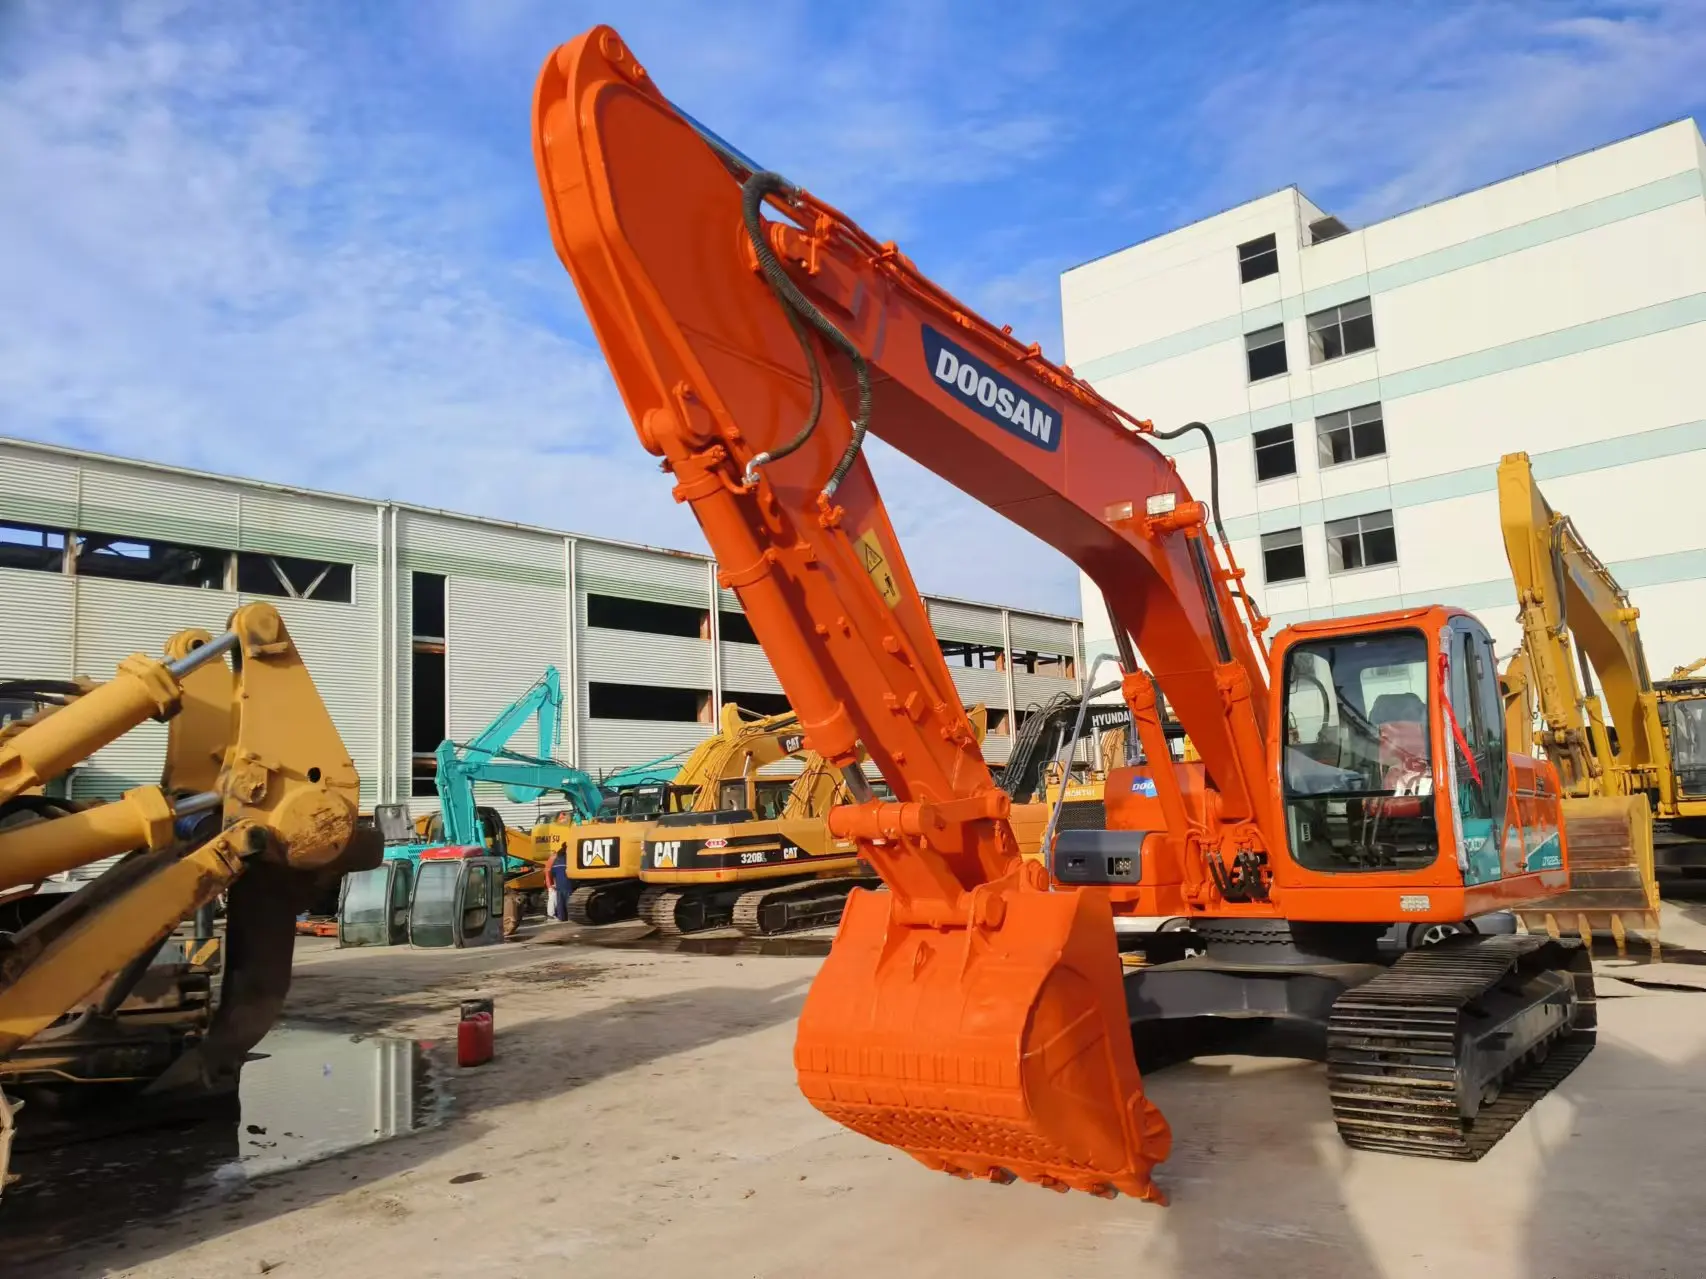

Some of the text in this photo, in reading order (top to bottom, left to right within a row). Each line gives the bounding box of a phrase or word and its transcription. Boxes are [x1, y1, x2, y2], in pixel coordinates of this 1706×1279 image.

[936, 348, 1053, 444] DOOSAN
[785, 736, 800, 752] CAT
[582, 839, 614, 867] CAT
[654, 841, 681, 868] CAT
[783, 847, 798, 860] CAT
